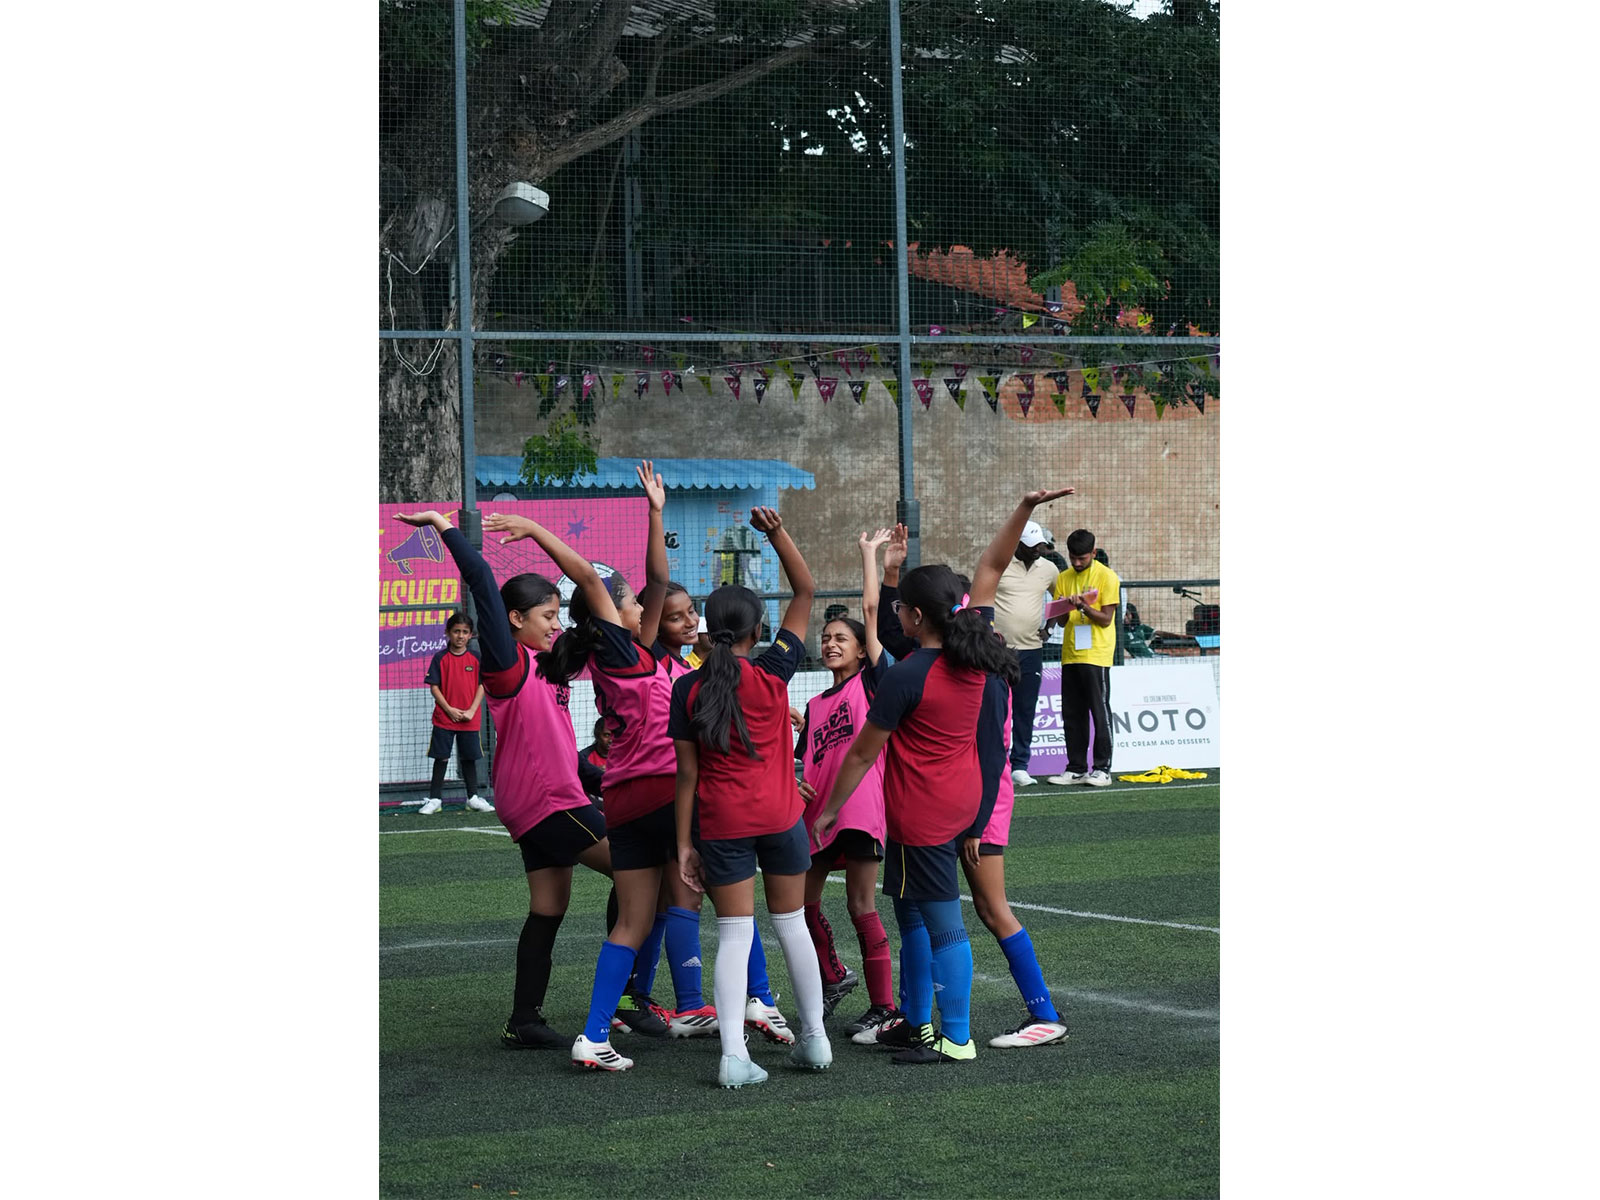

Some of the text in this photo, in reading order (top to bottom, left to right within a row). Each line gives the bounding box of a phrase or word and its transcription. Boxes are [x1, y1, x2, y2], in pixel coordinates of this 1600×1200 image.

[379, 578, 457, 626] ISHER
[1112, 708, 1206, 734] NOTO
[1132, 740, 1158, 748] CREAM
